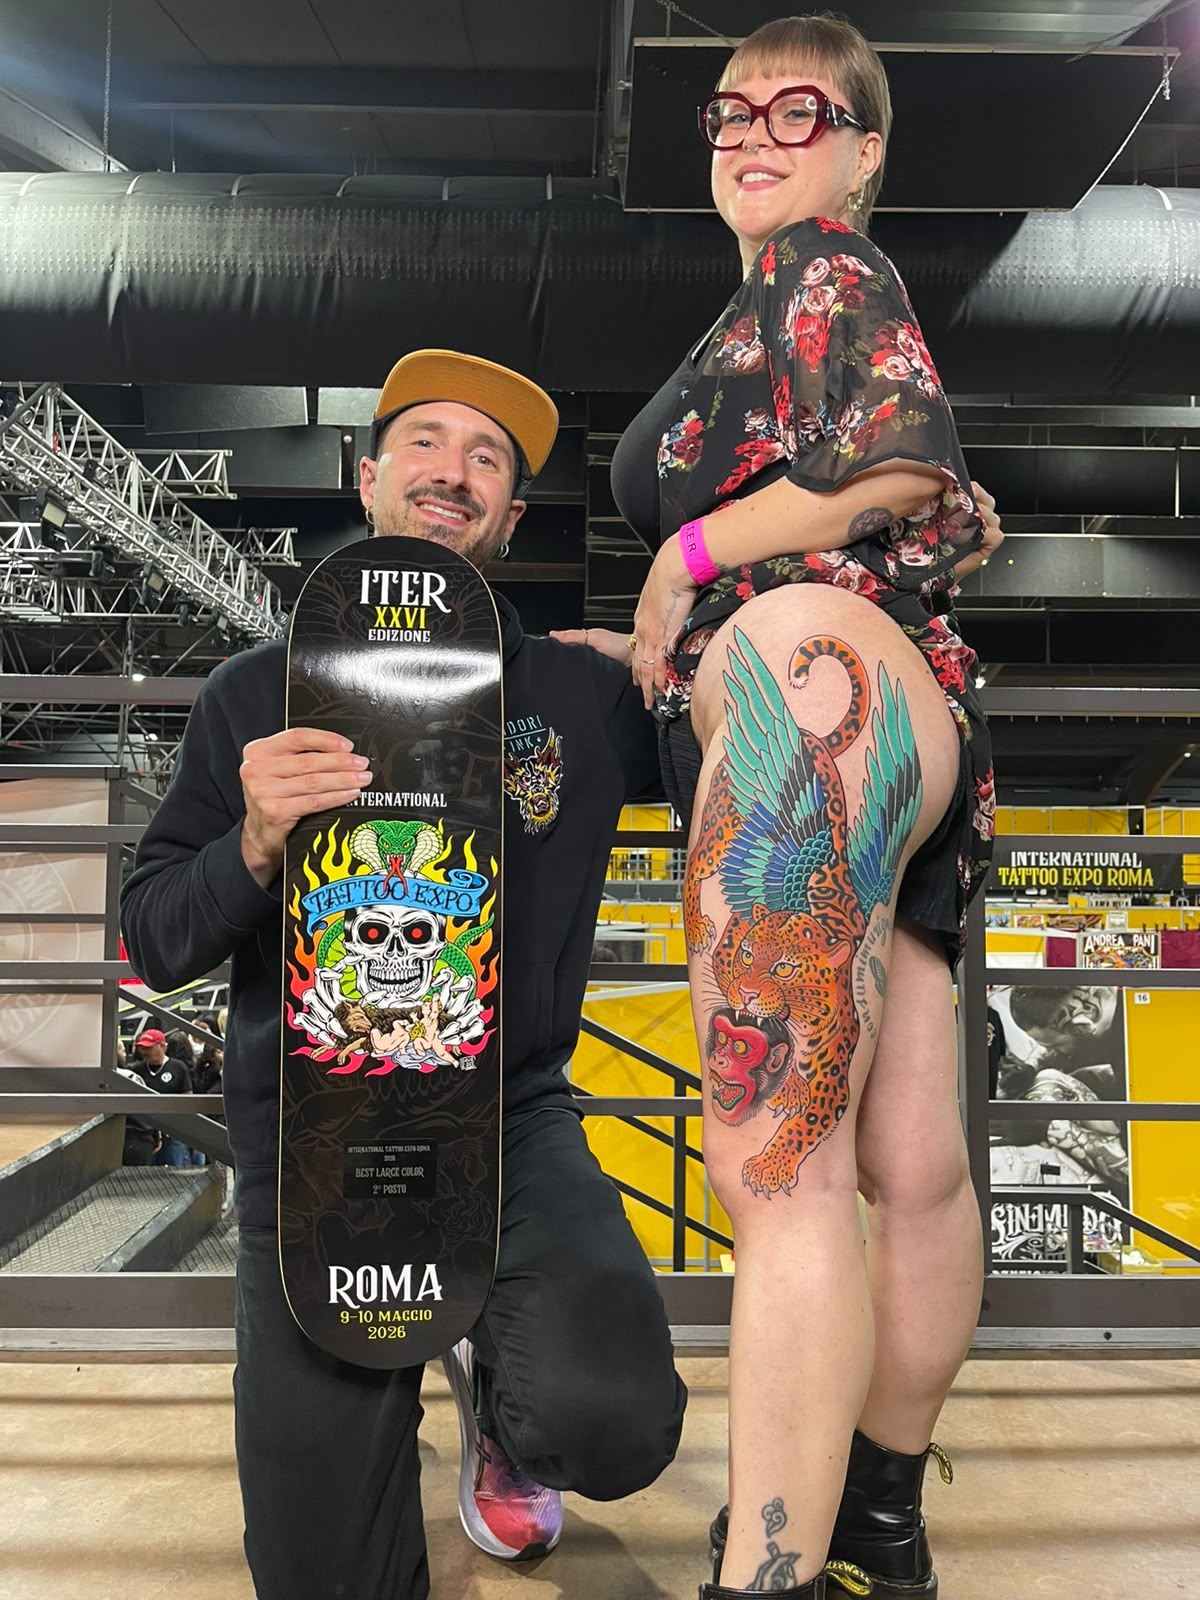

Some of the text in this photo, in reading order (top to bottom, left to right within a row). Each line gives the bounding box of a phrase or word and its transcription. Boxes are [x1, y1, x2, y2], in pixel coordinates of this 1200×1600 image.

[359, 569, 452, 615] ITER
[373, 606, 427, 630] XXVI
[367, 628, 431, 643] EDIZIONE
[504, 715, 543, 736] DORI
[509, 736, 534, 753] INK
[346, 791, 448, 808] TERNATIONAL
[1010, 851, 1142, 868] INTERNATIONAL
[998, 868, 1154, 887] TATTOO EXPO ROMA
[308, 879, 474, 914] TATTOO EXPO
[1084, 934, 1155, 955] ANDREA PANI
[1137, 994, 1148, 1002] 16
[355, 1167, 425, 1178] BEST LARGE COLOR
[372, 1184, 407, 1195] 2° POSTO
[328, 1263, 444, 1309] ROMA
[340, 1309, 433, 1324] 9-10 MAGGIO
[368, 1325, 407, 1339] 2026
